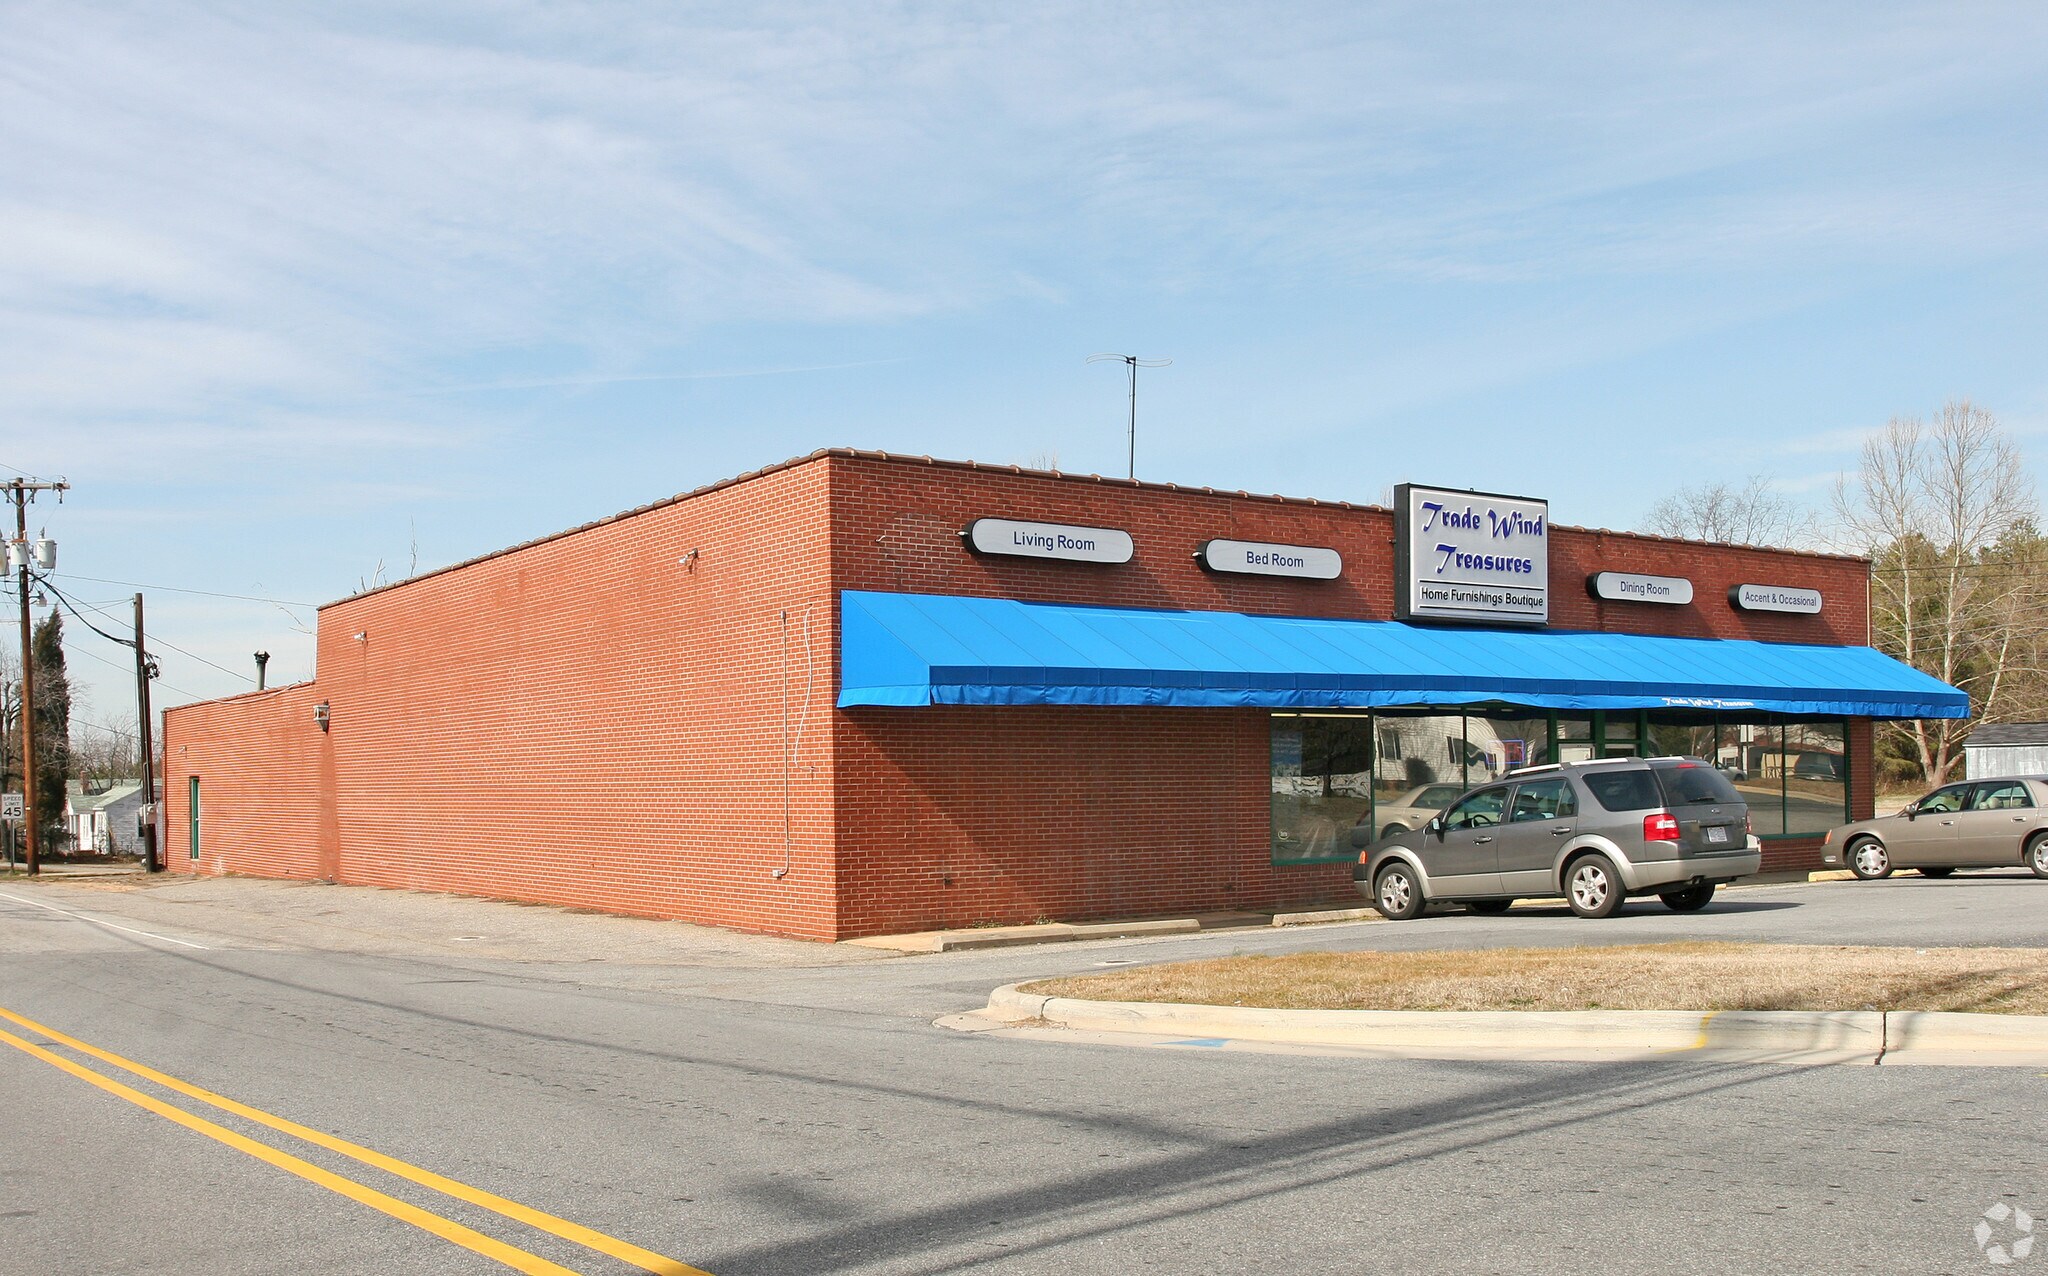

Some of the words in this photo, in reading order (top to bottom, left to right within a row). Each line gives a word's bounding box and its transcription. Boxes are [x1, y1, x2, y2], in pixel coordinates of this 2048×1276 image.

[1420, 501, 1481, 532] Trade
[1486, 507, 1543, 539] Wind
[1013, 530, 1054, 551] Living
[1057, 535, 1096, 551] Room
[1246, 551, 1269, 566] Bed
[1271, 553, 1304, 568] Room
[1434, 543, 1532, 574] Treasures
[1421, 586, 1449, 601] Home
[1451, 589, 1503, 606] Furnishings
[1505, 593, 1543, 609] Boutique
[1620, 581, 1645, 596] Dining
[1646, 583, 1670, 596] Room
[1744, 591, 1770, 603] Accent
[1771, 593, 1777, 604] &
[1778, 594, 1817, 607] Occasional
[3, 807, 21, 816] 45
